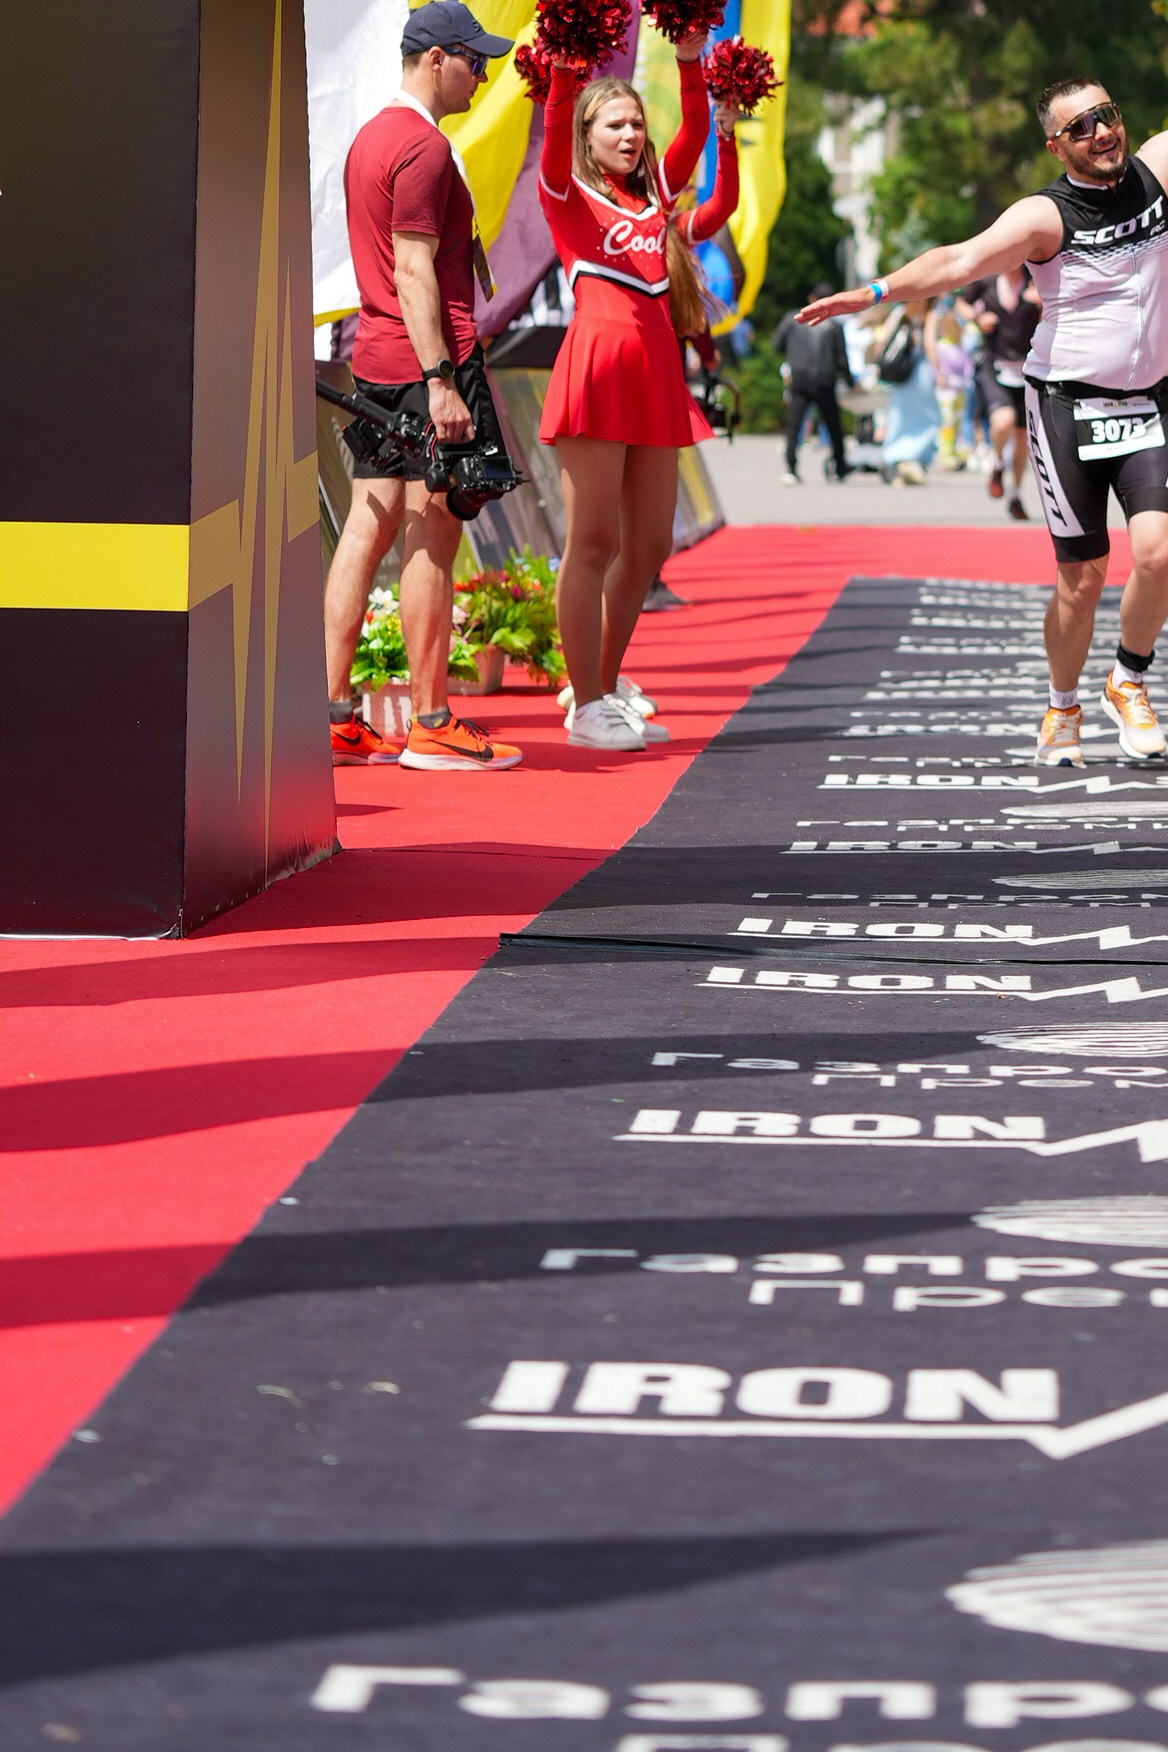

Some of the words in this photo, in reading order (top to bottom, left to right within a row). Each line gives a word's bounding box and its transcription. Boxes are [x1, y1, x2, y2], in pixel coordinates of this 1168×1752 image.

[1071, 194, 1164, 245] SCOTT
[603, 219, 666, 256] Cool
[1091, 416, 1147, 443] 3073
[824, 773, 1039, 786] IRON
[790, 839, 1038, 851] IRON
[738, 918, 1032, 938] IRON
[707, 967, 1032, 991] IRON
[629, 1109, 1046, 1140] IRON
[488, 1360, 1060, 1422] IRON
